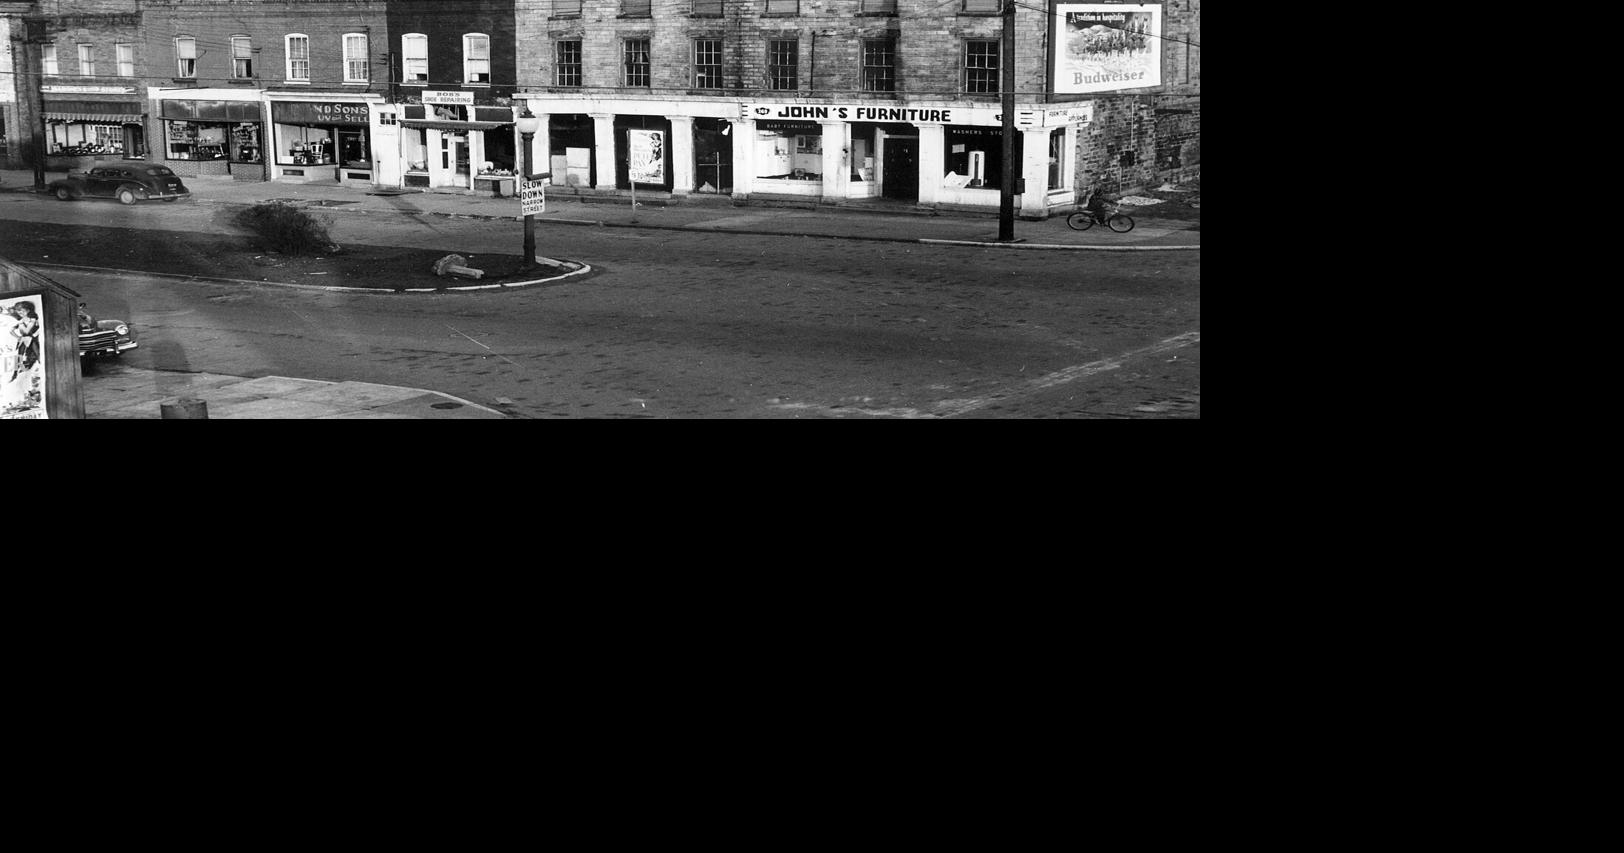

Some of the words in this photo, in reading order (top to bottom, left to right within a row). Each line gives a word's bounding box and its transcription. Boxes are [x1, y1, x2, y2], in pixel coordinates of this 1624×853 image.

[1073, 71, 1144, 85] Budweiser
[334, 104, 368, 115] SONS
[857, 107, 951, 122] FURNITURE
[522, 181, 542, 189] SLOW
[522, 190, 542, 200] DOWN
